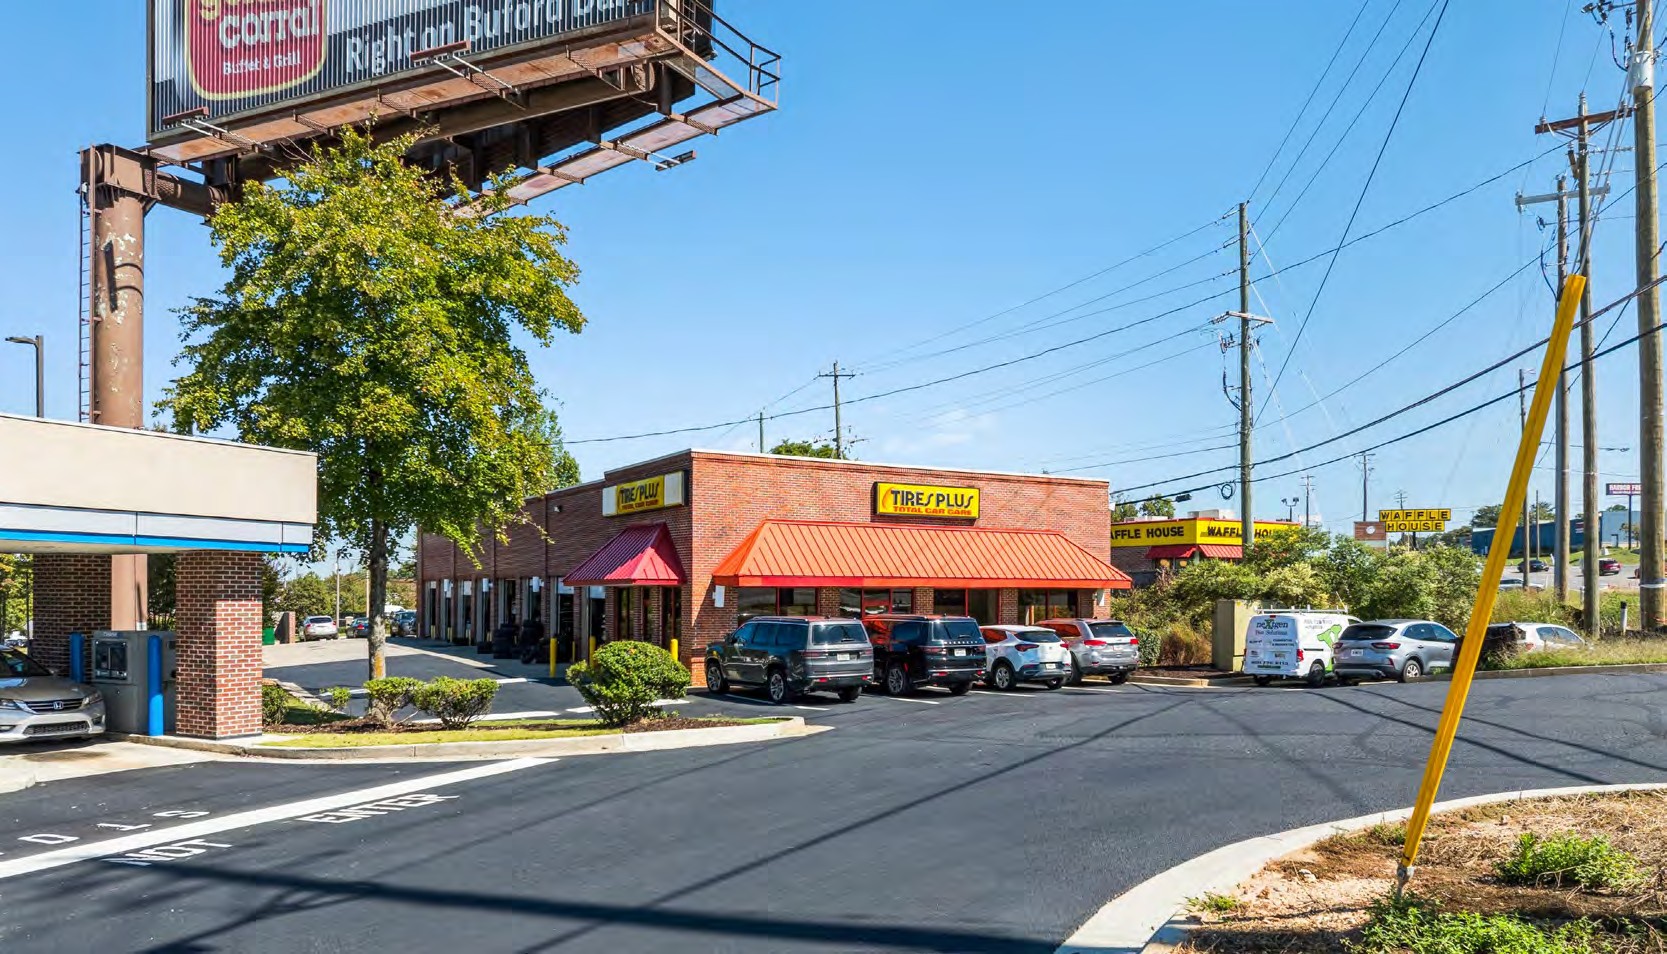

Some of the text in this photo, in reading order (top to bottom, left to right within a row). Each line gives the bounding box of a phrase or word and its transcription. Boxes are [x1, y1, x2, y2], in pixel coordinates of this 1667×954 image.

[346, 25, 415, 76] Right
[464, 0, 563, 42] Buford
[222, 57, 260, 76] Buffet
[273, 50, 301, 68] Grill
[639, 482, 660, 501] PLUS
[890, 489, 974, 509] TIRES PLUS
[893, 505, 923, 514] TOTAL
[924, 507, 945, 515] CAR
[1381, 510, 1449, 520] WAFFLE
[1146, 526, 1185, 538] HOUSE
[1207, 526, 1243, 538] WAFFL
[1387, 521, 1443, 531] HOUSE
[295, 793, 461, 823] ENTER
[101, 838, 233, 867] NOT
